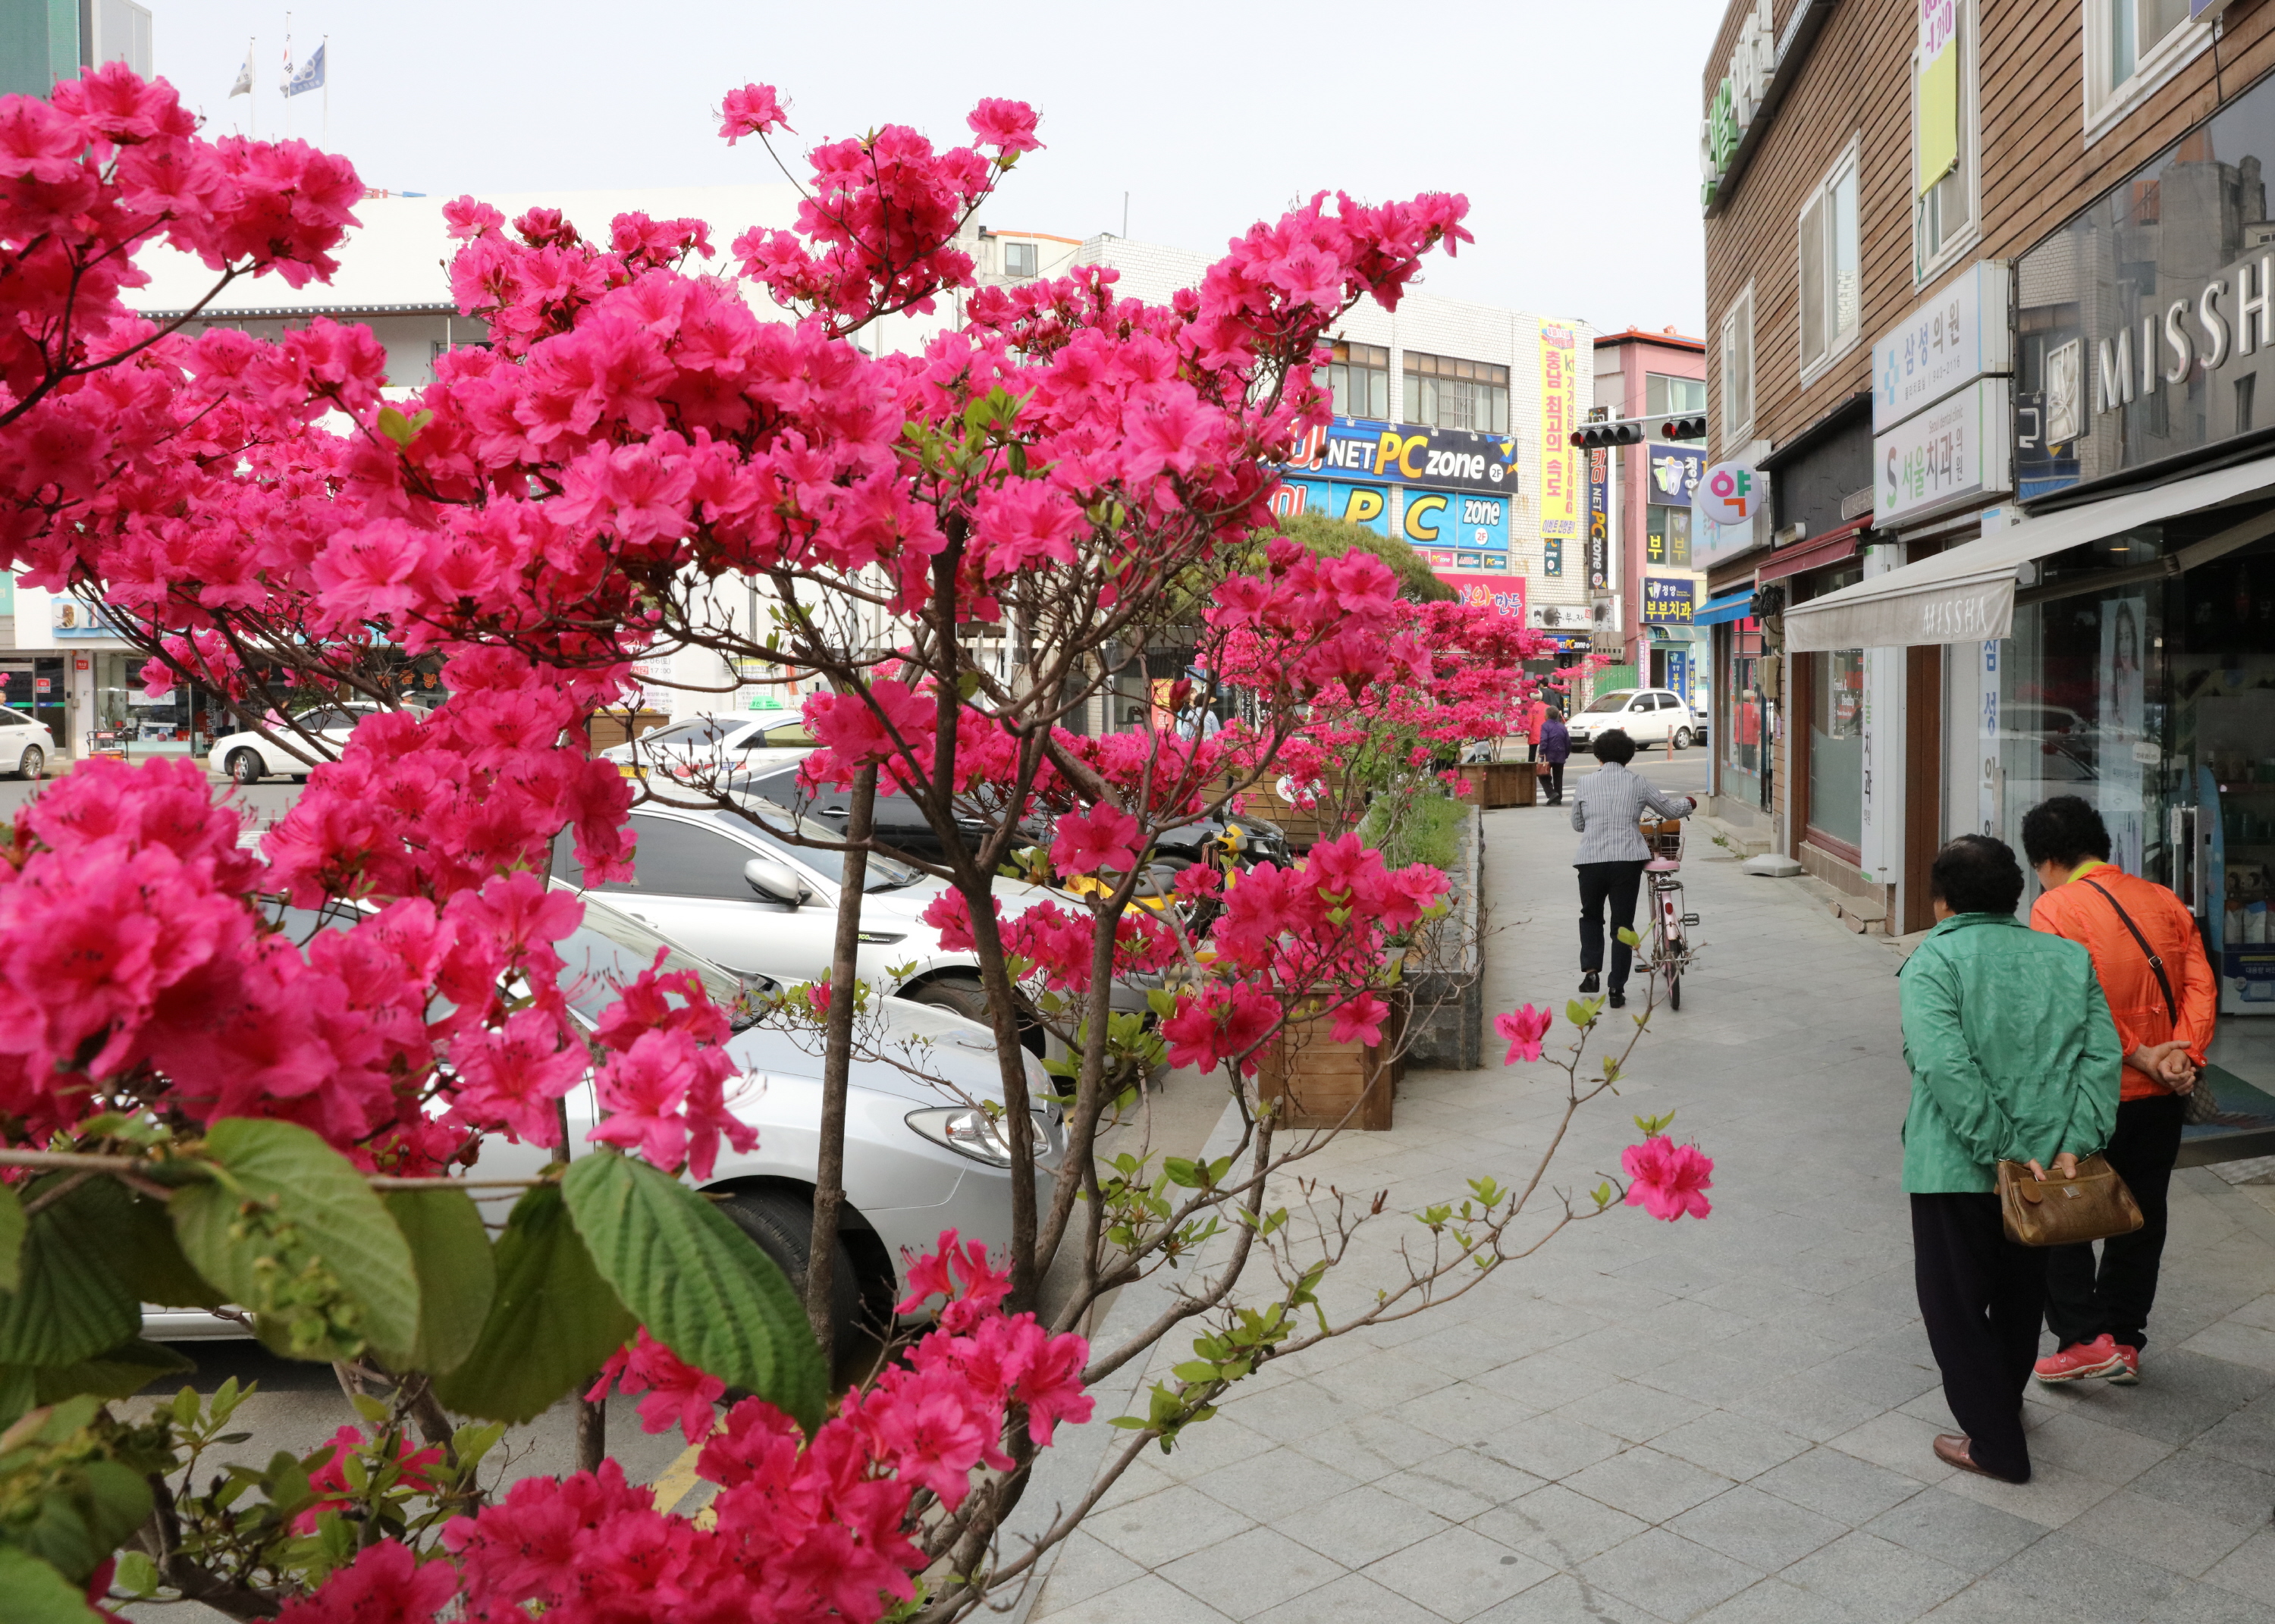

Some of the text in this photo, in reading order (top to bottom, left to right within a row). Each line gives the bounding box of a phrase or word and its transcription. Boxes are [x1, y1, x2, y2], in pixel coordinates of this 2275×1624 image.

[1547, 337, 1574, 349] OPEN
[1904, 298, 1960, 376] 삼성의원
[1933, 355, 1960, 383] 943-2116
[1545, 350, 1563, 497] 충남 최고의 속도
[1928, 404, 1963, 434] Seoul dental clinic
[1328, 438, 1376, 469] NET
[1491, 468, 1502, 479] 2F
[1593, 488, 1602, 511] NET
[1710, 470, 1752, 517] 약
[1463, 499, 1500, 525] zone
[1477, 532, 1486, 541] 2F
[1542, 519, 1558, 533] 이벤트
[1592, 538, 1602, 569] zone
[1648, 535, 1687, 561] 부 부
[1662, 585, 1677, 597] 청양
[1646, 600, 1692, 621] 부부치과
